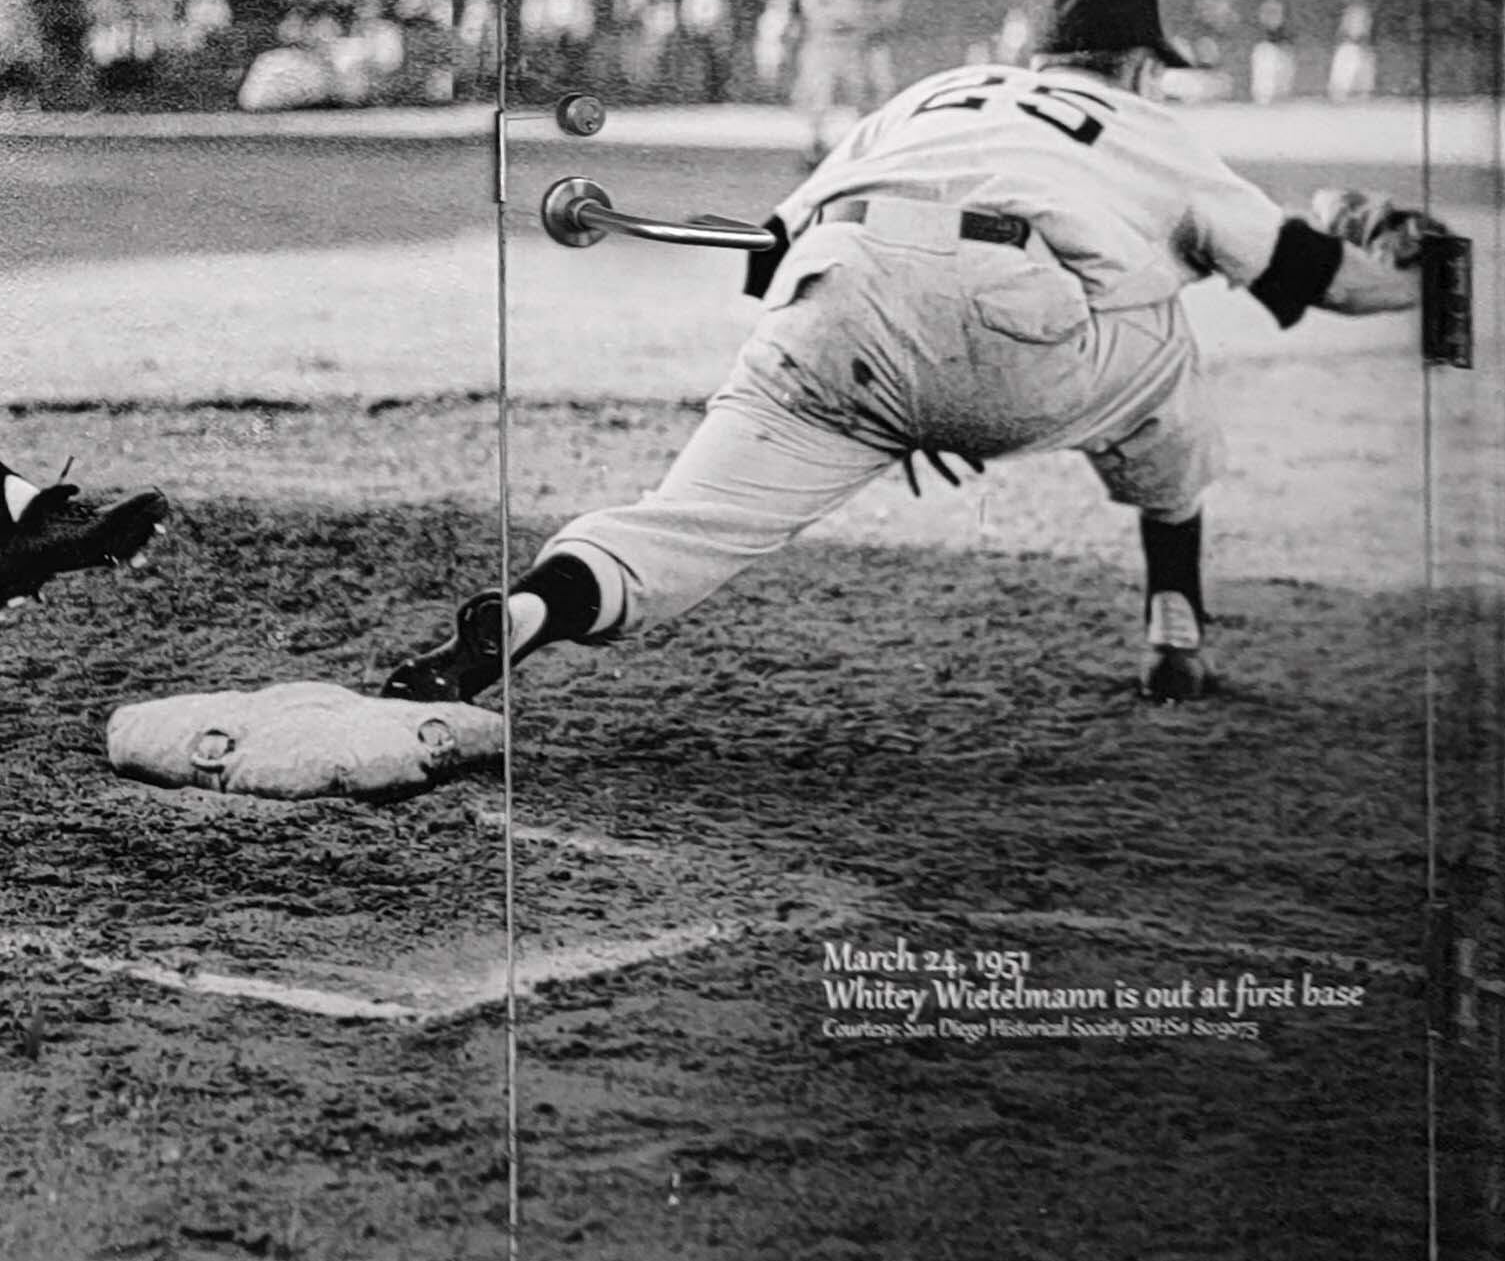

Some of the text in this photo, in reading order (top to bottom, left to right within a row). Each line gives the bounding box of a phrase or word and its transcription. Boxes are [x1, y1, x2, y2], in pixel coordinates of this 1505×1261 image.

[822, 936, 1031, 980] March 24, 1951
[822, 972, 1366, 1022] Whitey Wietelmann is out at first base
[903, 1021, 937, 1038] San
[939, 1017, 987, 1044] Diego
[990, 1014, 1069, 1038] Historical
[1071, 1016, 1128, 1043] Society
